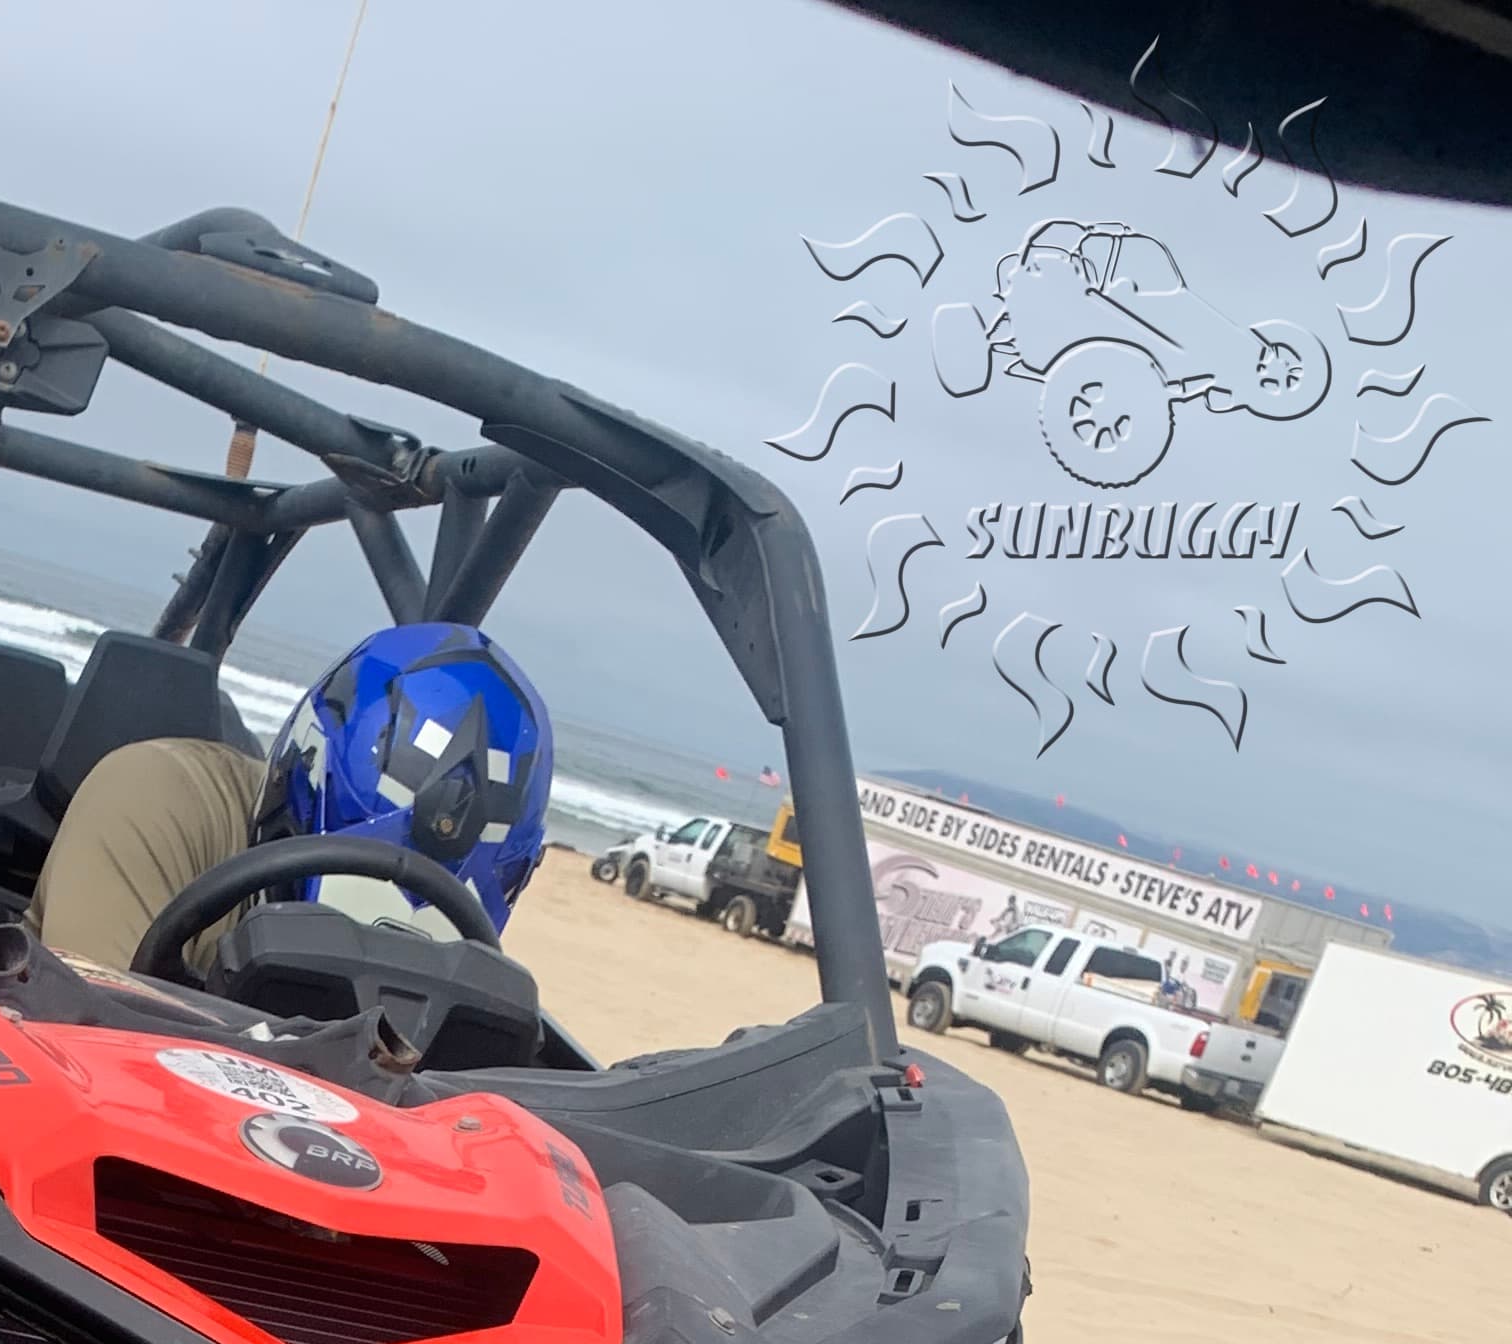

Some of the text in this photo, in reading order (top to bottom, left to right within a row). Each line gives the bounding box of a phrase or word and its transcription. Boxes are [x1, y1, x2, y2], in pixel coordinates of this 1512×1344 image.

[859, 788, 1254, 931] AND SIDE BY SIDES RENTALS STEVE'S ATV
[230, 1087, 317, 1118] 402
[306, 1144, 377, 1172] BRP
